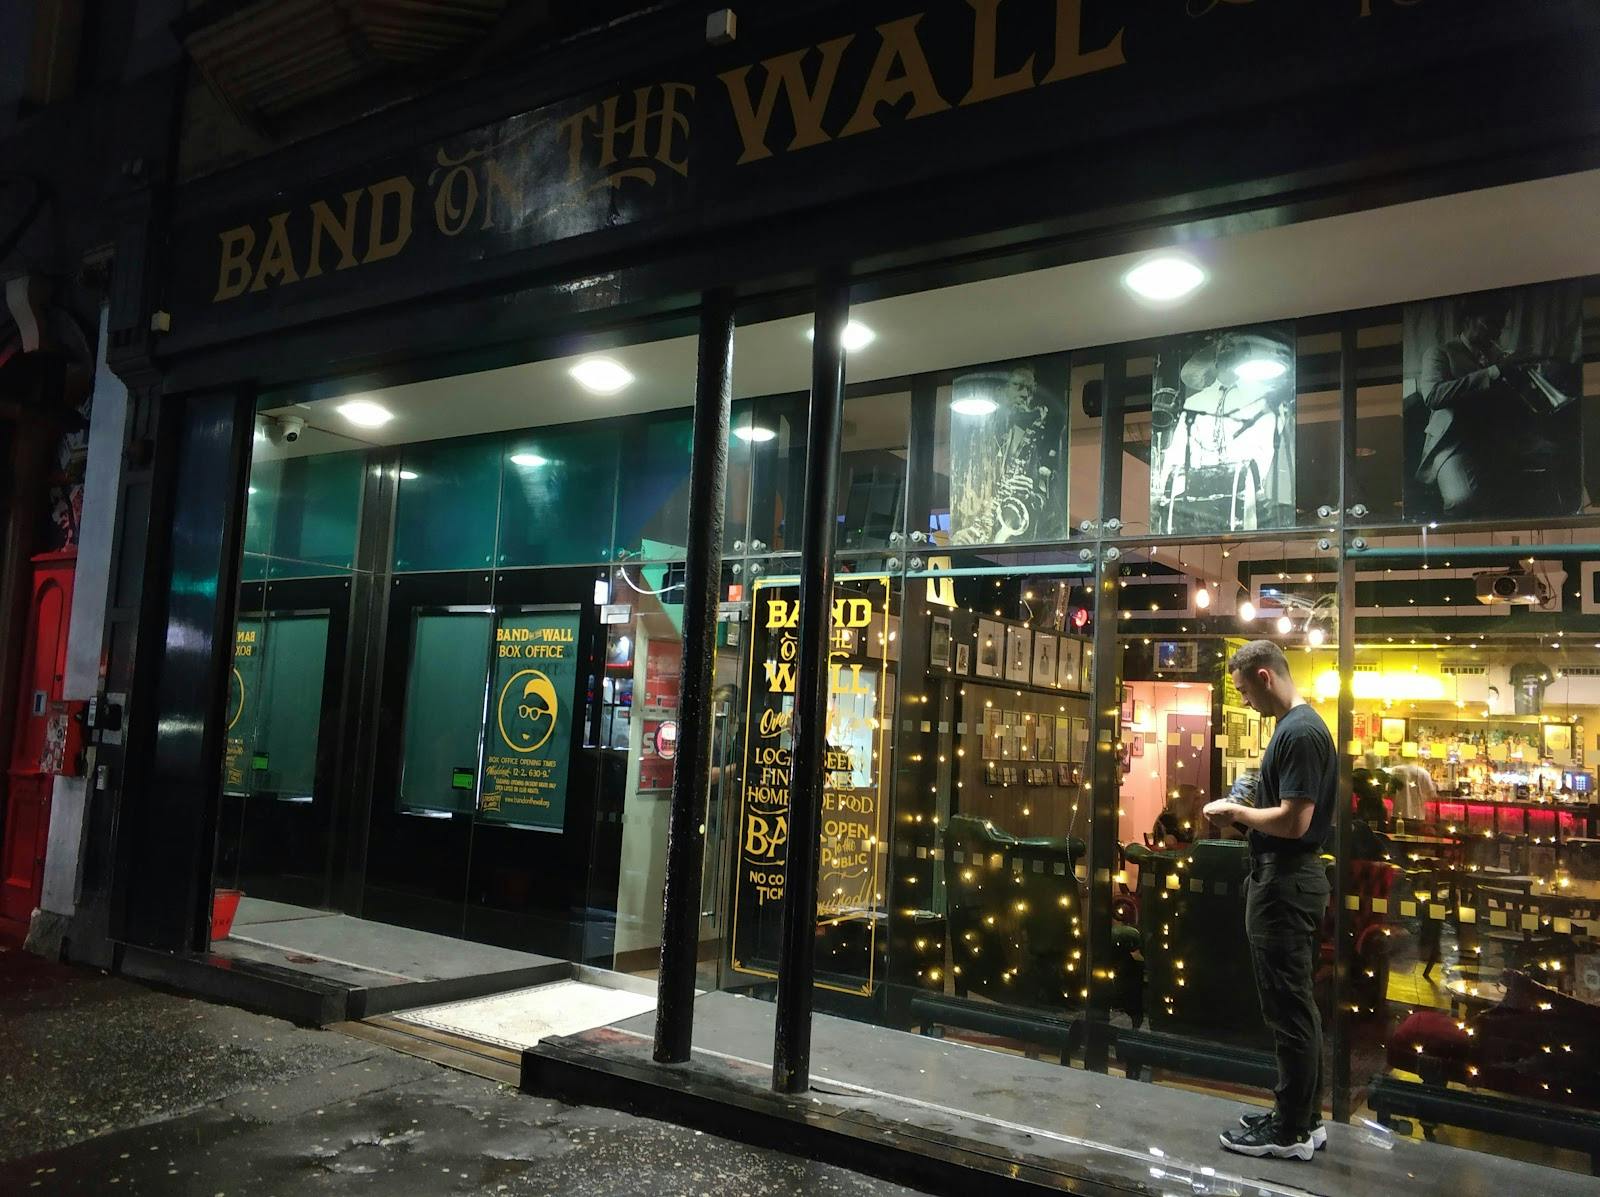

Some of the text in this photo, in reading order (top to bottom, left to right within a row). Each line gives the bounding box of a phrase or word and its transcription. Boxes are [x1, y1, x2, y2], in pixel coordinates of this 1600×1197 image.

[213, 0, 1128, 304] BAND ON THE WALL
[496, 628, 529, 641] BAND
[542, 628, 574, 642] WALL
[498, 644, 564, 658] BOX OFFICE
[838, 794, 874, 813] FOOD
[824, 821, 870, 840] OPEN
[822, 847, 868, 868] PUBLIC
[749, 871, 766, 885] NO
